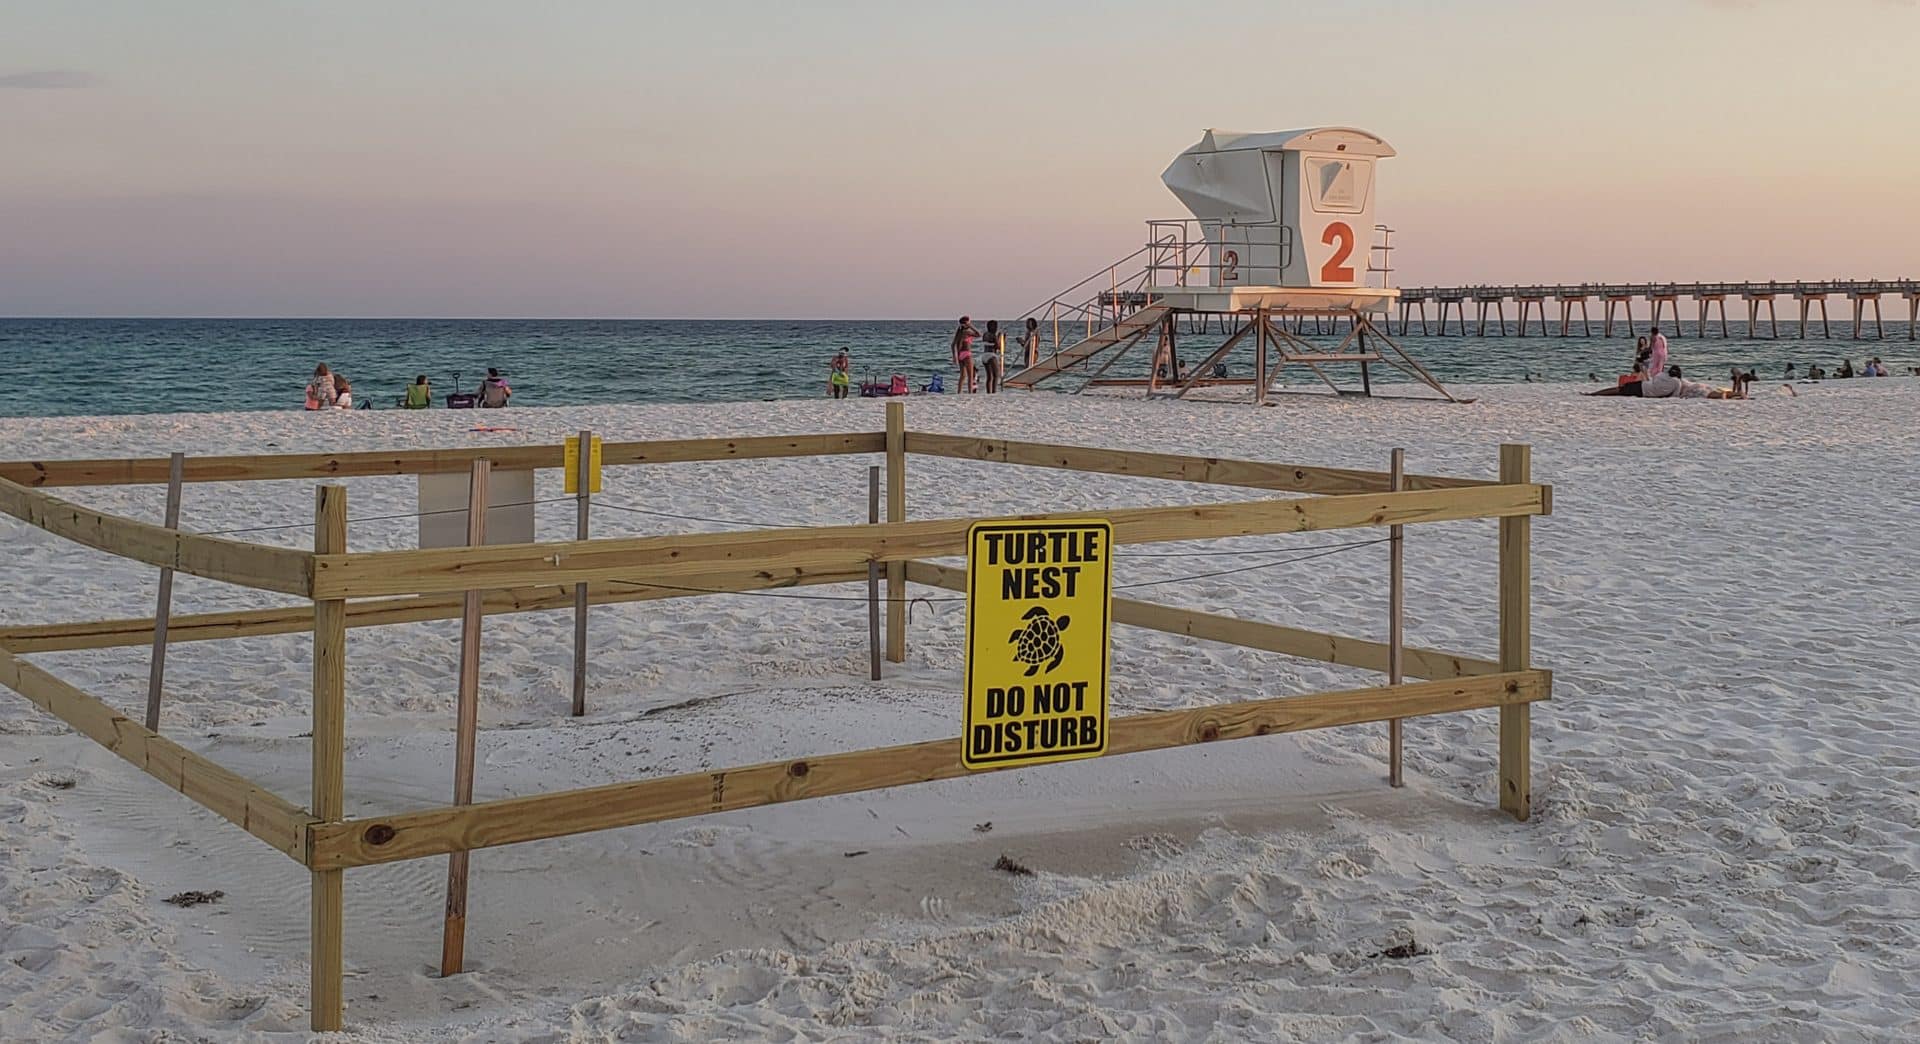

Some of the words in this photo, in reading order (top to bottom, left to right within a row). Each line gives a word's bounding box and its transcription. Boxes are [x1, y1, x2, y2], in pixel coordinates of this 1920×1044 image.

[1223, 250, 1239, 280] 2
[1321, 221, 1354, 282] 2
[984, 531, 1099, 565] TURTLE
[1002, 566, 1081, 600] NEST
[986, 686, 1025, 719] DO
[1033, 681, 1089, 714] NOT
[973, 716, 1097, 755] DISTURB
